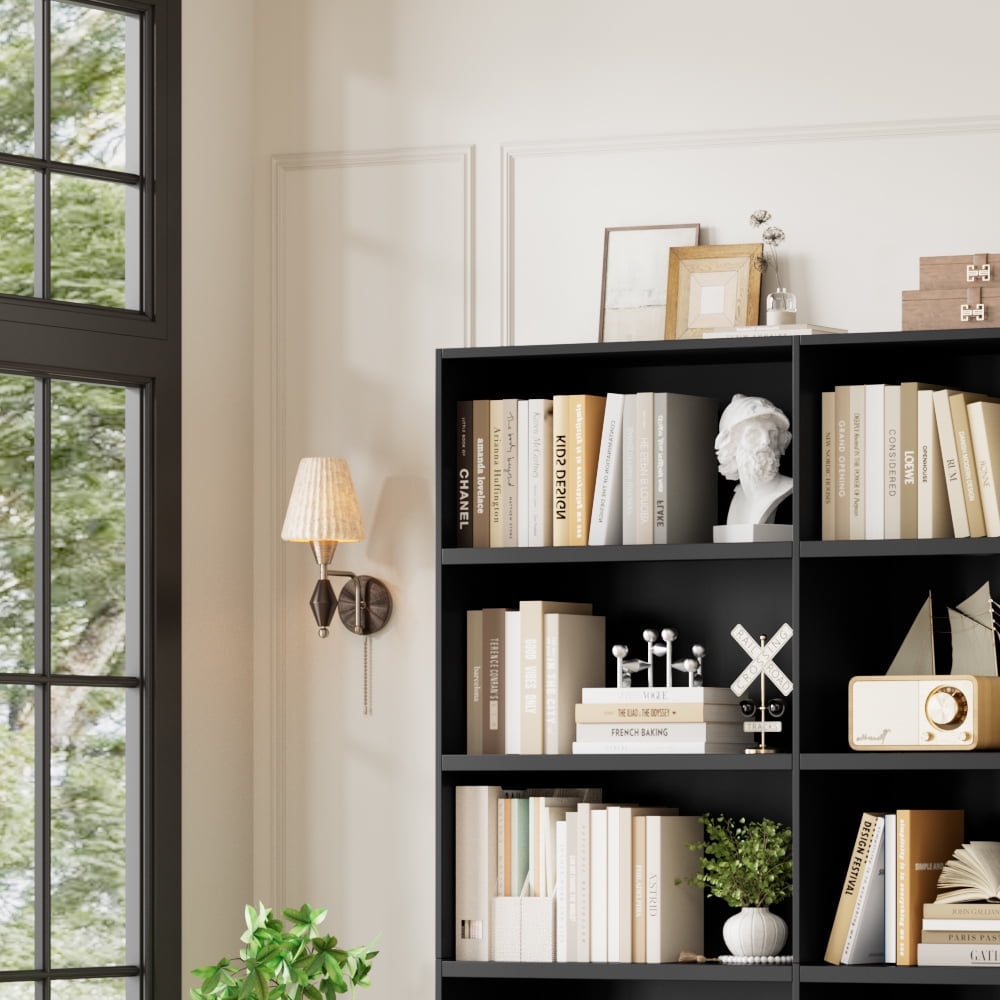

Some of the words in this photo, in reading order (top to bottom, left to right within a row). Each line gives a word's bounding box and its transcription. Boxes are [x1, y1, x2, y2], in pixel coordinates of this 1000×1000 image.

[477, 438, 485, 474] amanda
[959, 431, 967, 452] DANISH
[888, 429, 896, 497] CONSIDERED
[904, 451, 914, 485] LOEWE
[946, 459, 958, 482] RUM
[962, 454, 971, 479] MODERN
[459, 468, 469, 529] CHANEL
[477, 477, 486, 514] lovelace
[492, 470, 501, 523] Huffington
[966, 480, 975, 501] DESIGN
[490, 638, 498, 668] TERENCE
[525, 639, 536, 660] GOOD
[490, 669, 498, 699] CONRAN'S
[525, 666, 536, 689] VIBES
[525, 694, 536, 714] ONLY
[857, 821, 872, 855] DESIGN
[845, 857, 862, 896] FESTIVAL
[649, 874, 657, 917] ASTRID
